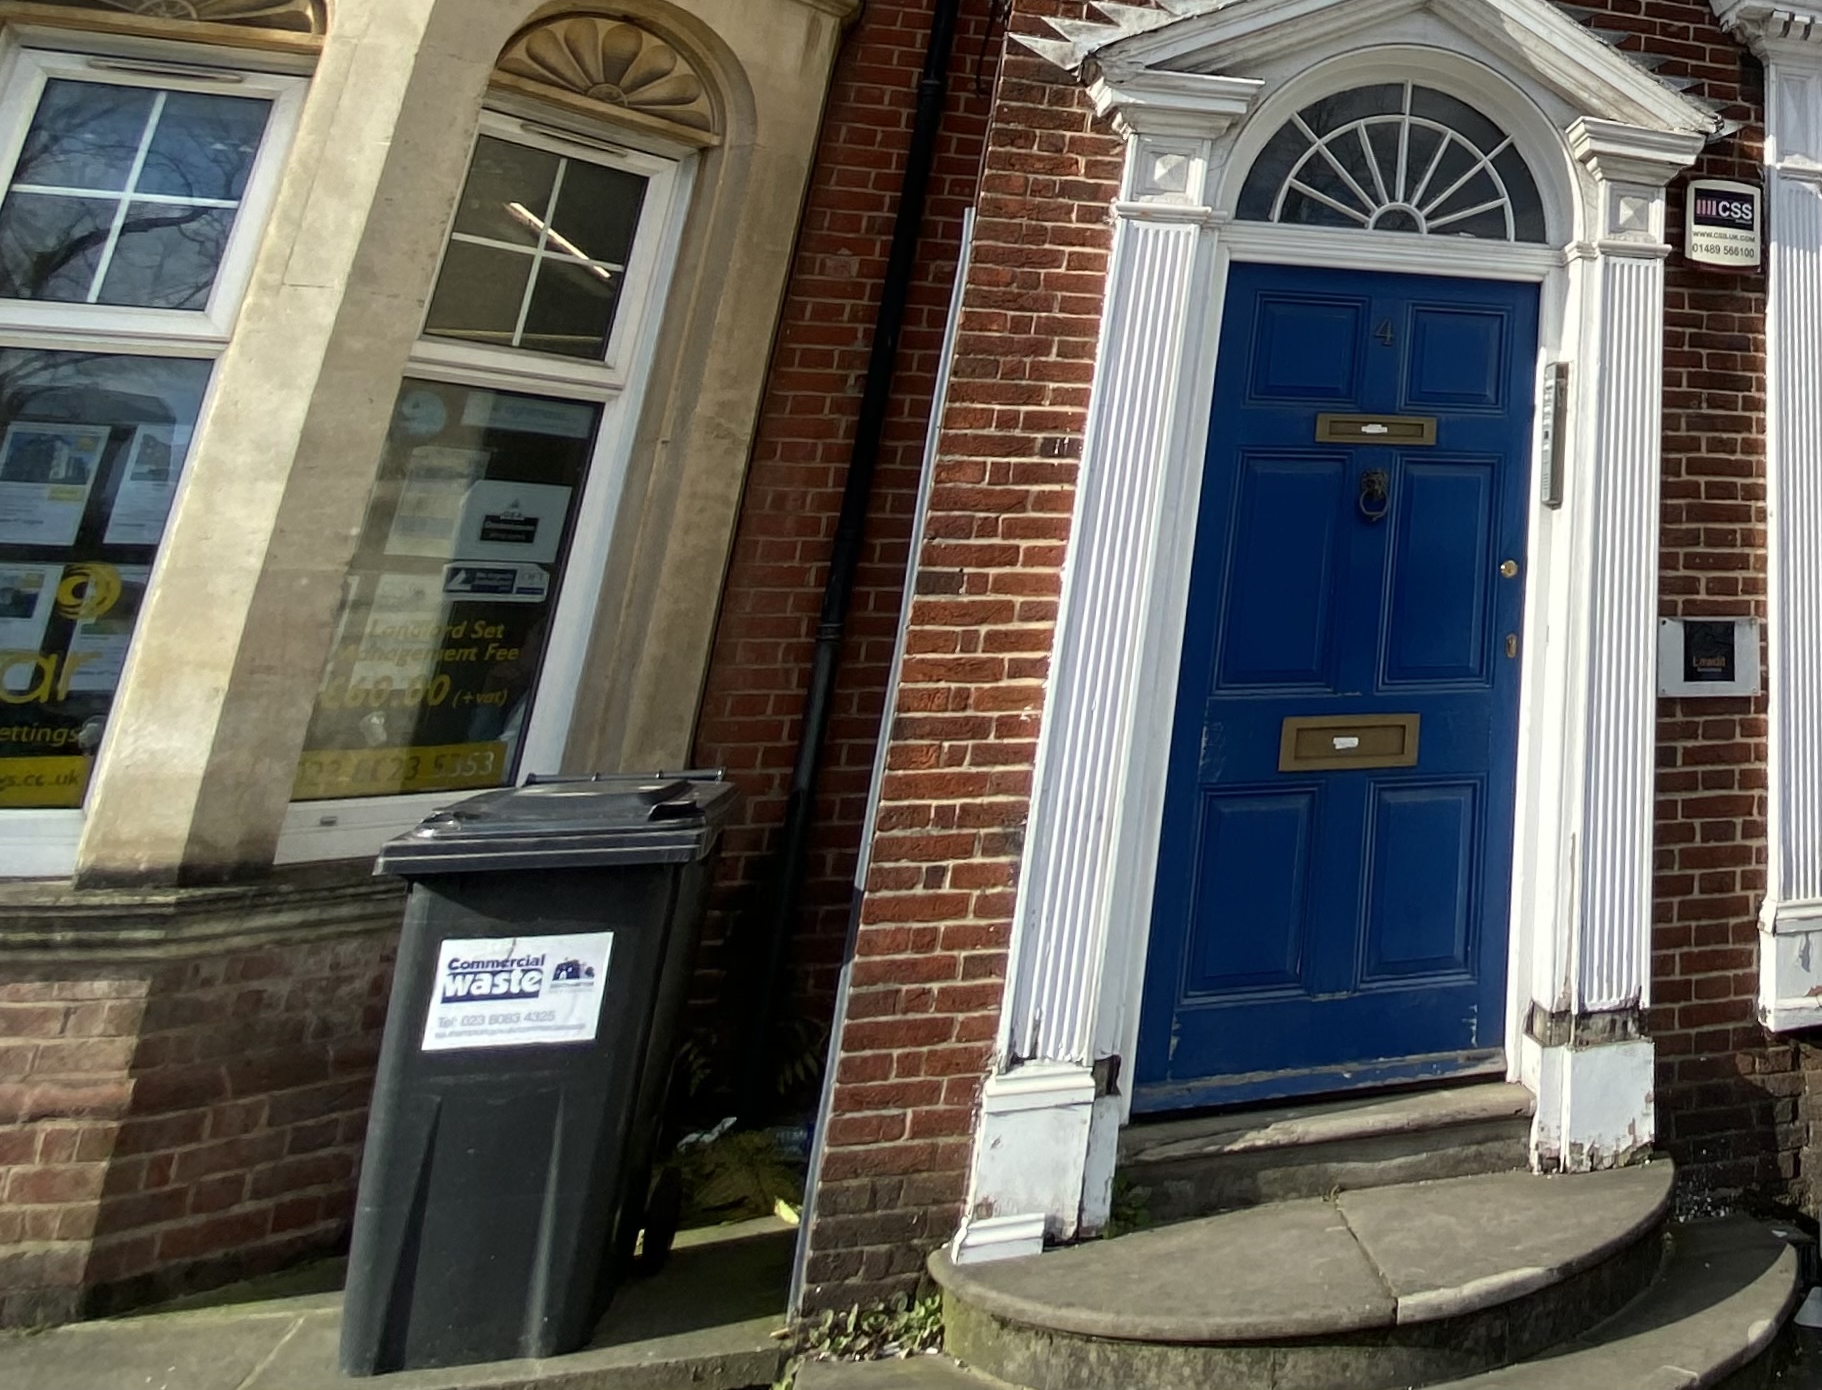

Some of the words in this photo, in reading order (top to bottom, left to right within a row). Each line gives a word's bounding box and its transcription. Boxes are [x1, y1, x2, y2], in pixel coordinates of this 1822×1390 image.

[1718, 200, 1753, 220] CSS
[1692, 243, 1721, 255] 01489
[1723, 245, 1755, 259] 566100
[1374, 318, 1395, 347] 4
[471, 620, 506, 639] Set
[484, 643, 521, 662] Fee
[446, 953, 547, 971] Commercial
[442, 967, 544, 998] waste
[460, 1014, 486, 1027] 023
[523, 1010, 556, 1023] 4325
